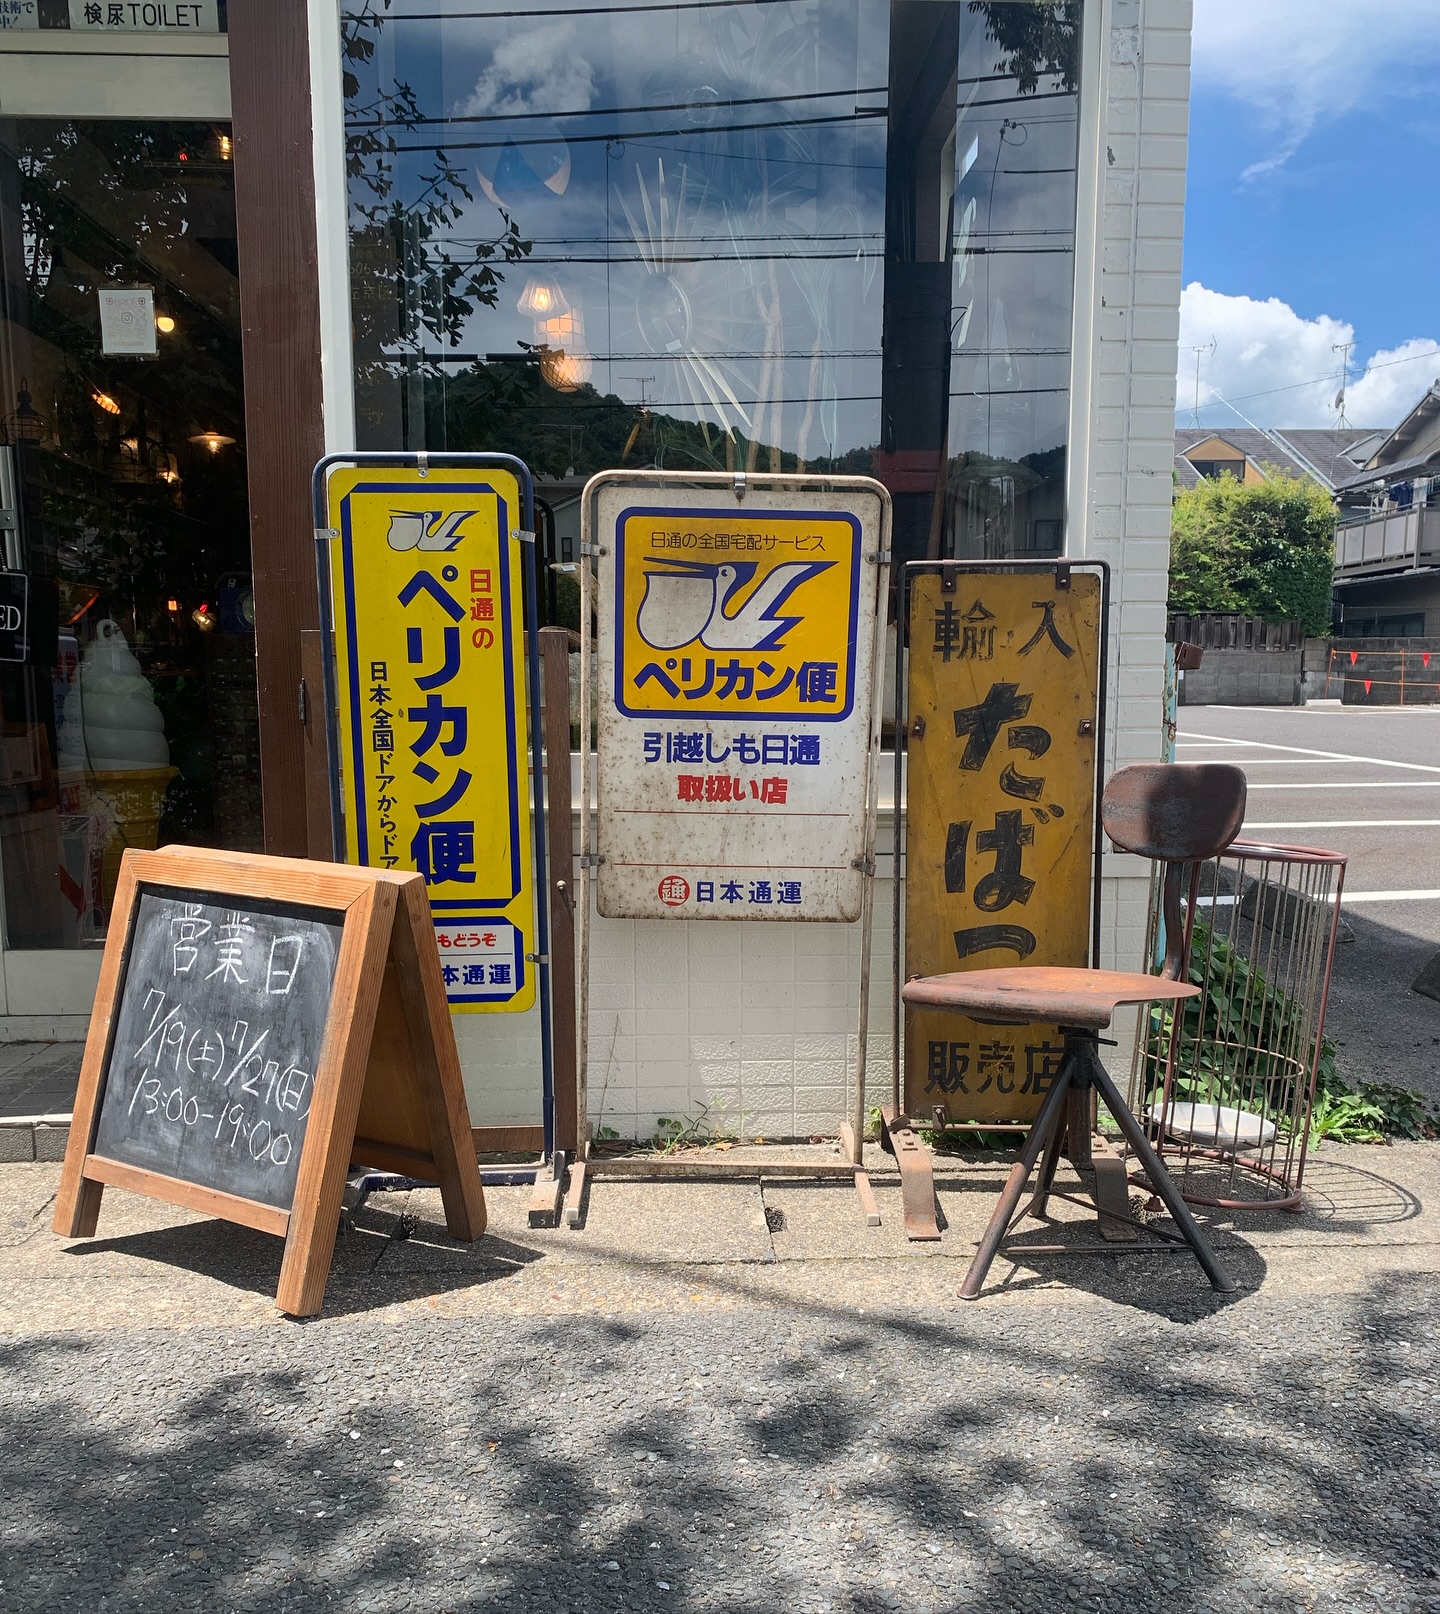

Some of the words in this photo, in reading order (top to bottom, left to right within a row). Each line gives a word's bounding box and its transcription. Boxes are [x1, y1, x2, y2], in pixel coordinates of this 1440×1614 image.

[651, 531, 826, 552] 日通の全国宅配サービス
[470, 569, 495, 650] 日通の
[932, 600, 1076, 663] 輸入
[633, 658, 839, 703] ペリカン便
[397, 564, 477, 886] ペリカン便
[643, 732, 821, 765] 引越しも日通
[368, 661, 400, 870] 日本全国ドアからドア
[677, 774, 788, 804] 取扱い店
[696, 880, 803, 904] 日本通運
[170, 903, 303, 995] 営業日
[134, 988, 225, 1081] 7/19(土)
[924, 1040, 1068, 1095] 販売店
[128, 1068, 292, 1165] 13:00-19:00
